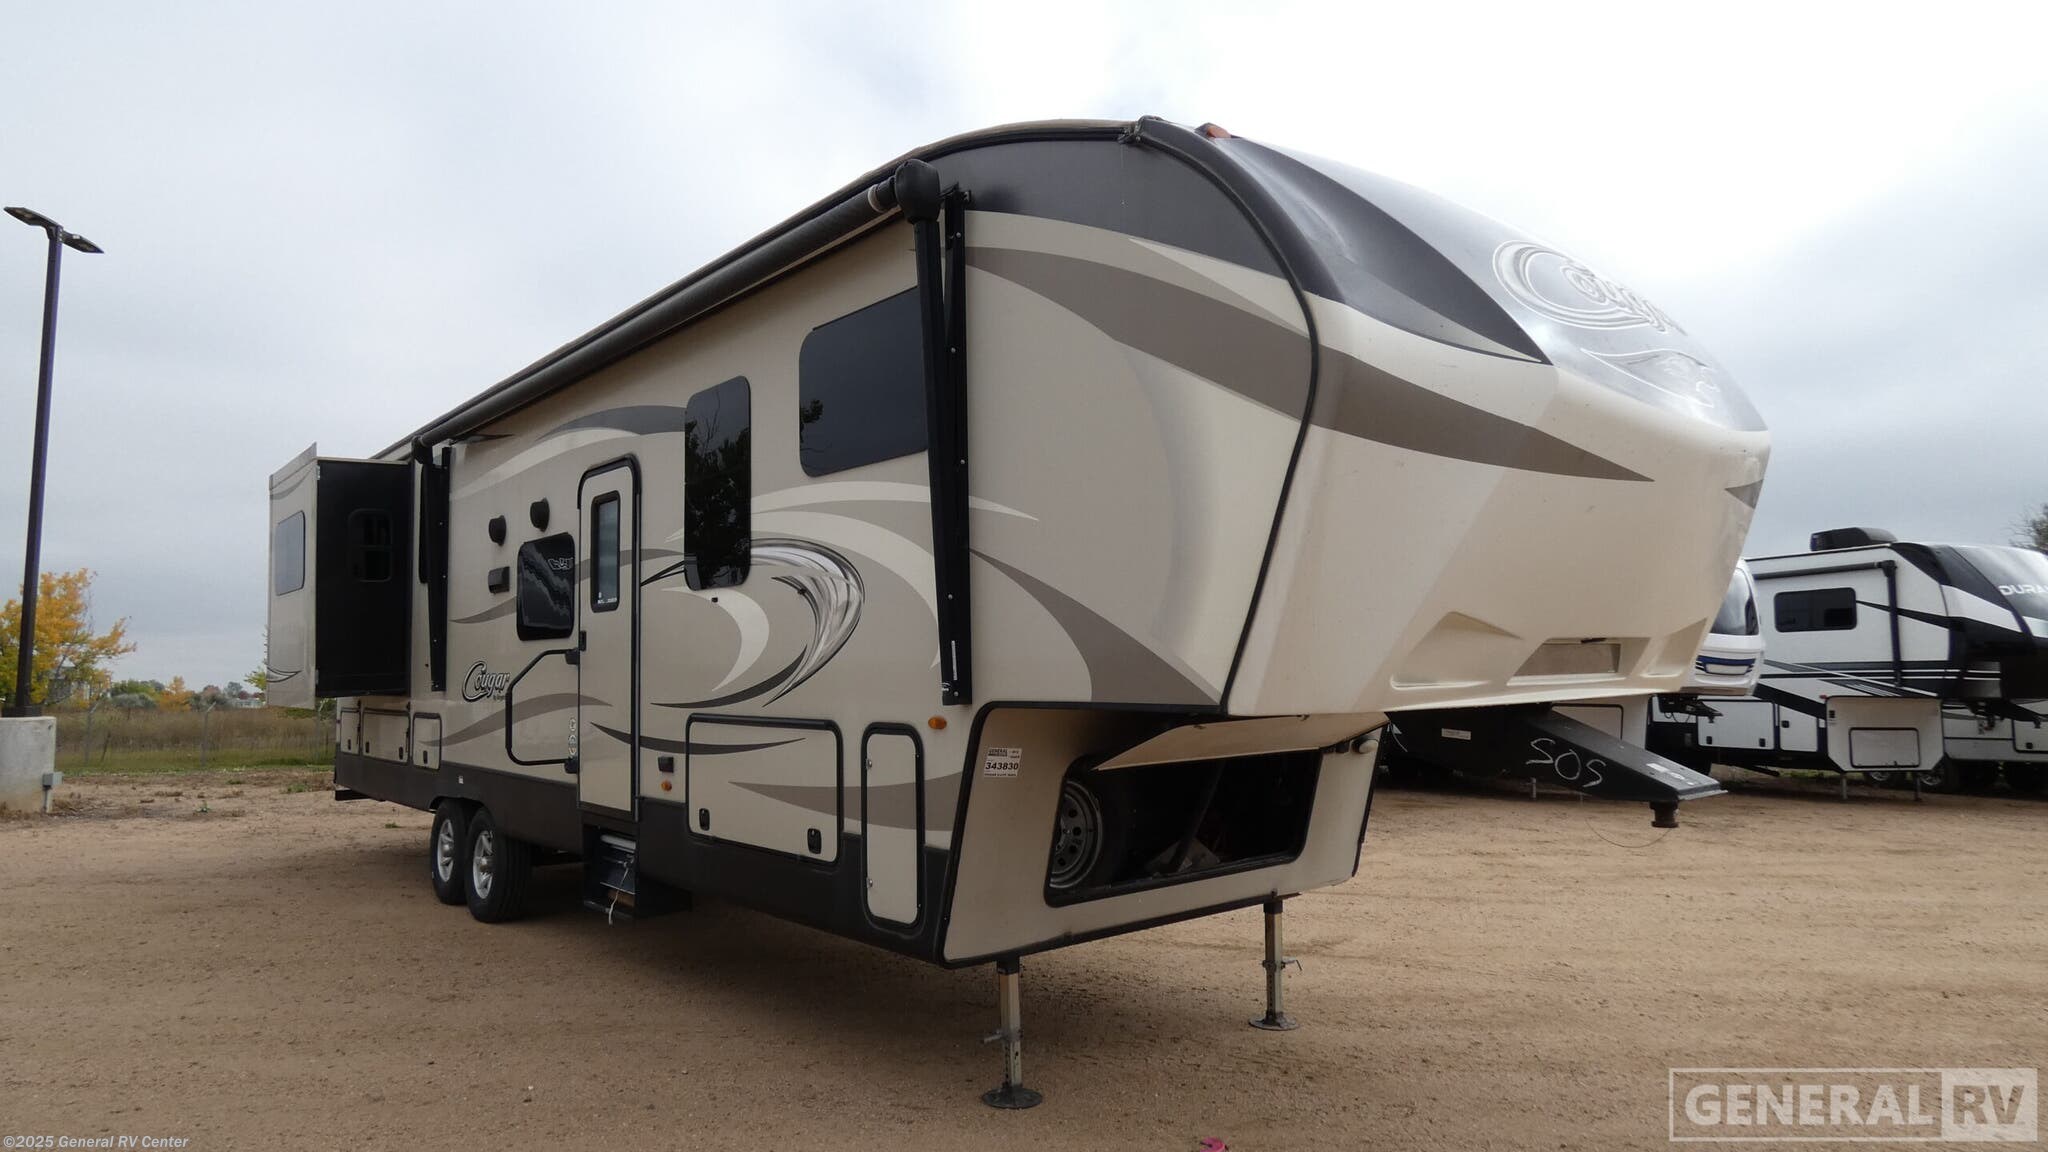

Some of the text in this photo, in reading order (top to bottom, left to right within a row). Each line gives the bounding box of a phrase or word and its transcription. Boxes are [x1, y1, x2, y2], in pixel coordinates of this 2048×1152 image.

[462, 660, 510, 702] Cougar
[985, 762, 1019, 770] 343830
[1526, 738, 1606, 787] SOS
